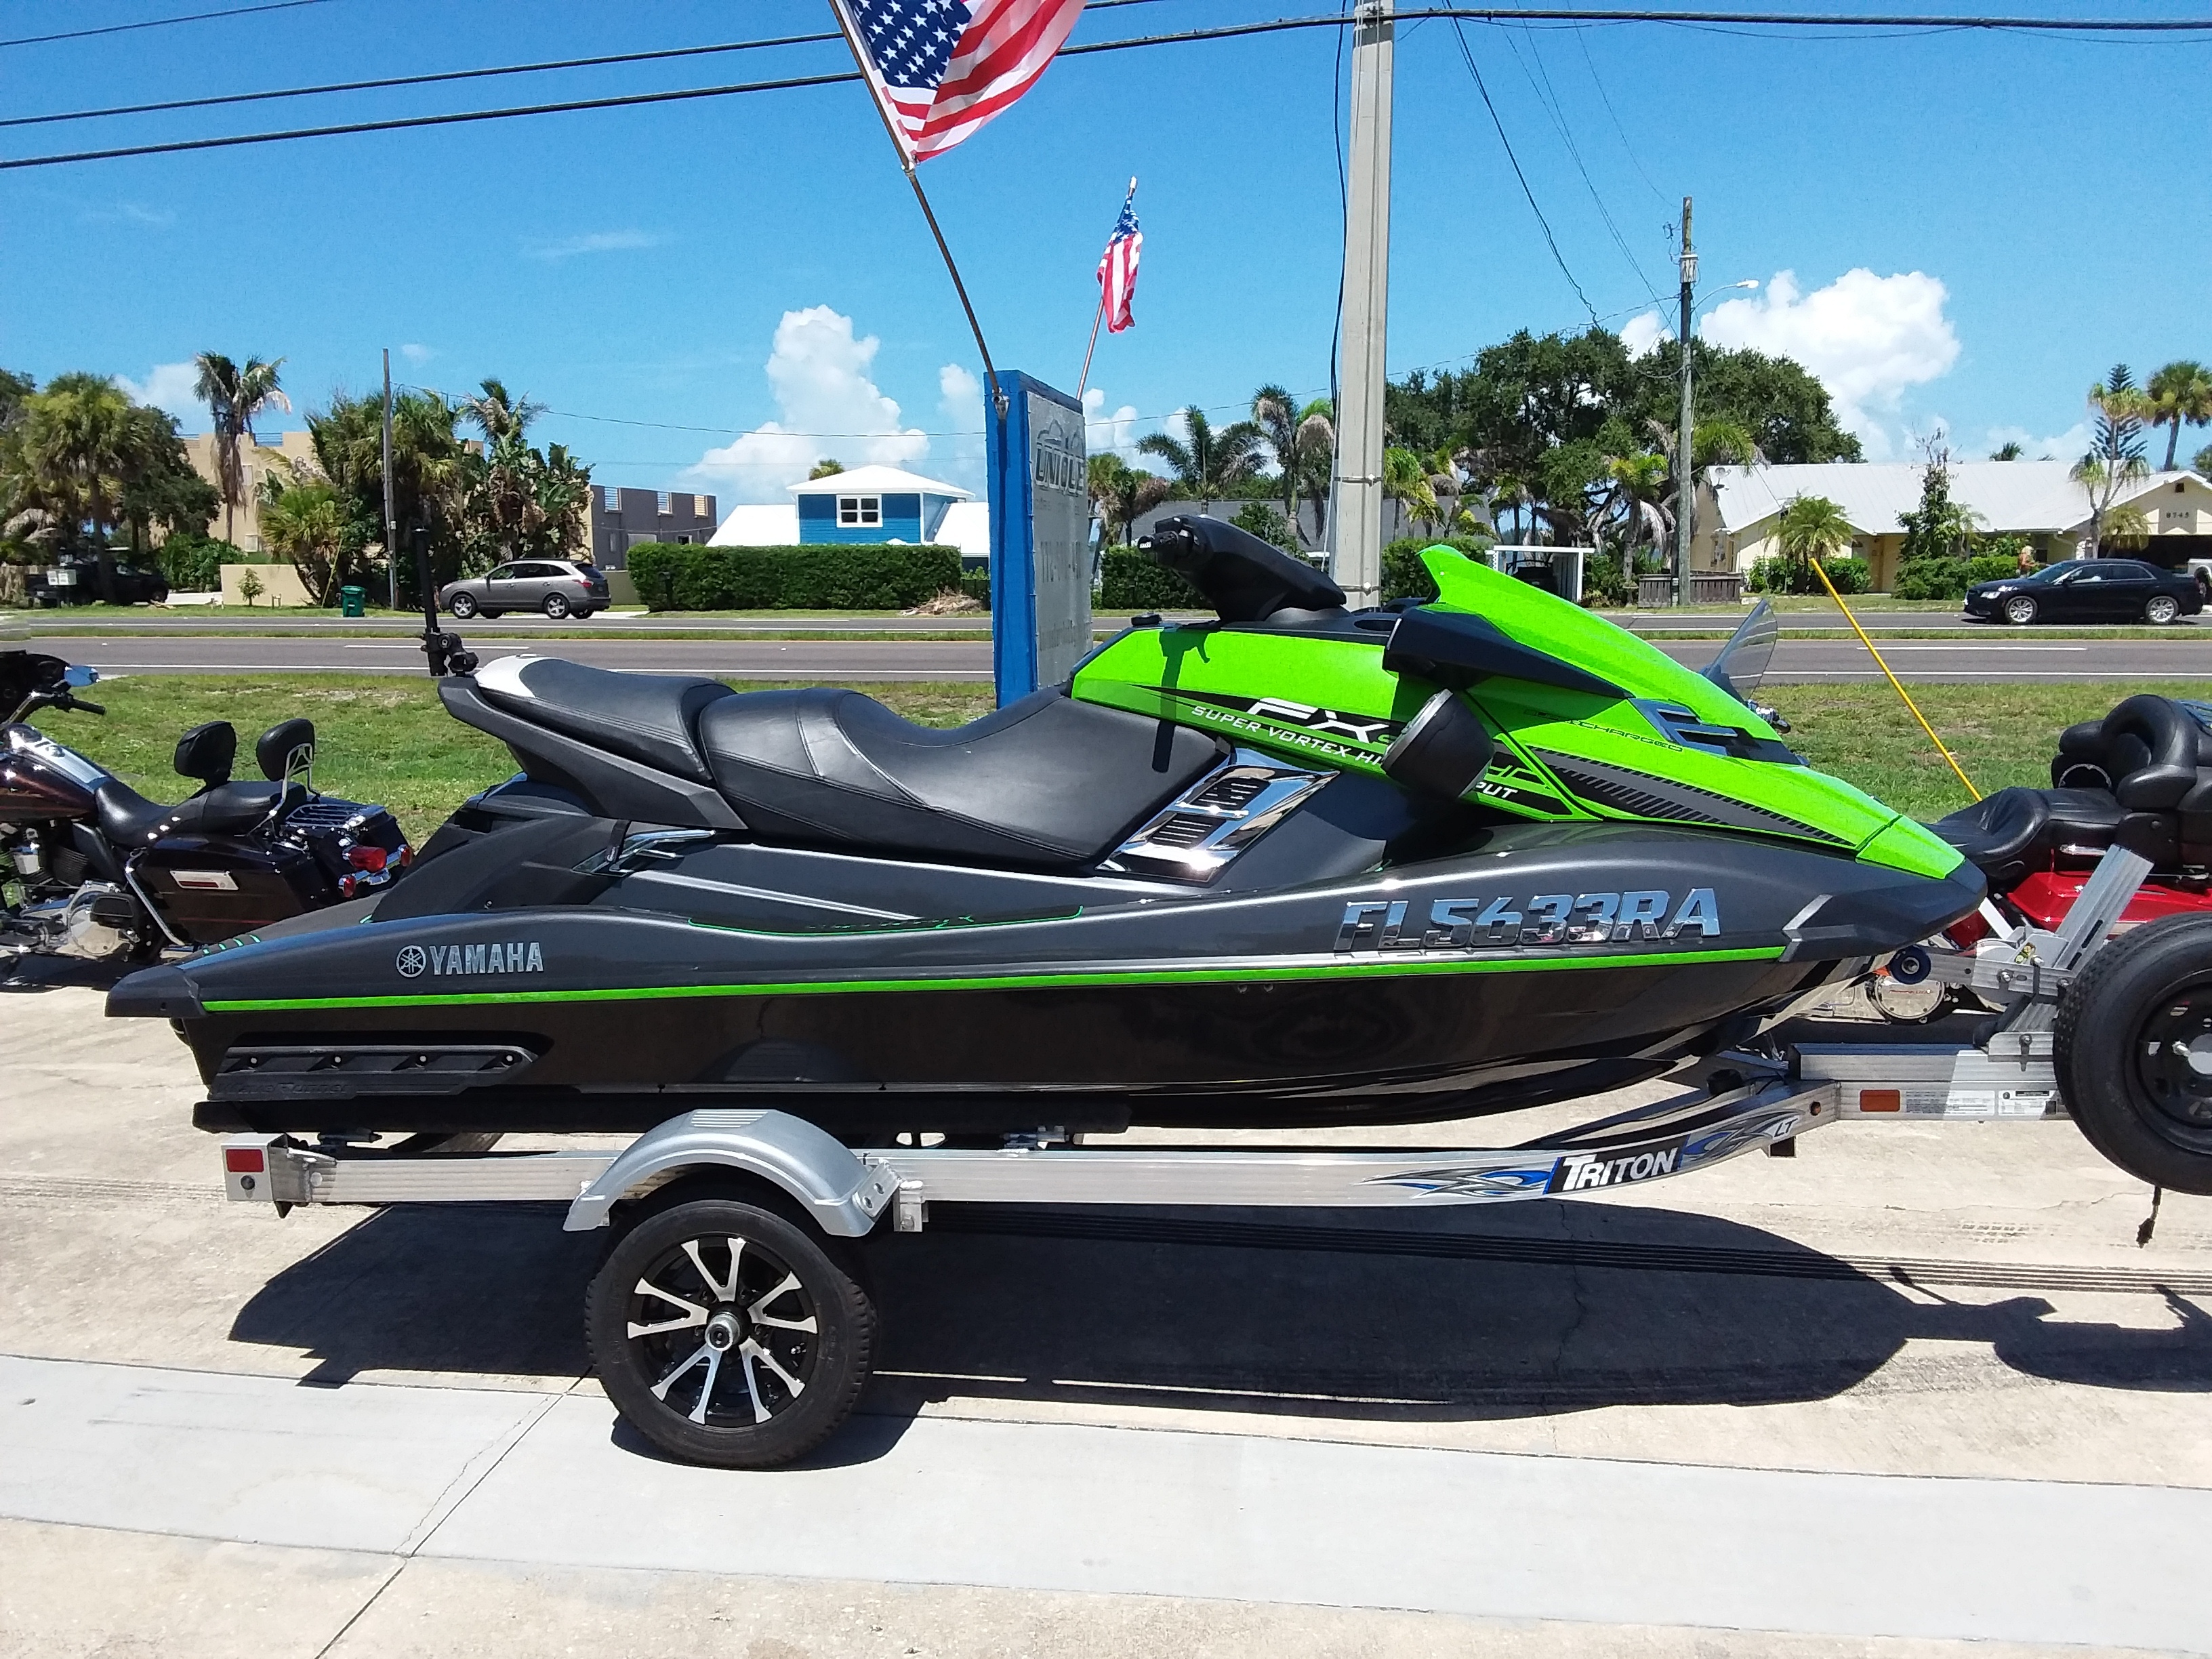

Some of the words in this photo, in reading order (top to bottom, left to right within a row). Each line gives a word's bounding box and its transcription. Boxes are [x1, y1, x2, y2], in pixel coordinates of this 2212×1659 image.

[1035, 447, 1084, 495] UNIQUE
[1246, 697, 1389, 743] FX
[1191, 705, 1262, 732] SUPER
[1269, 726, 1352, 758] VORTEX
[1355, 751, 1382, 766] HI
[1475, 781, 1519, 798] PUT
[1333, 888, 1721, 951] FL5633RA
[429, 943, 544, 975] YAMAHA
[1773, 1117, 1799, 1139] LT
[1563, 1148, 1679, 1191] TRITON
